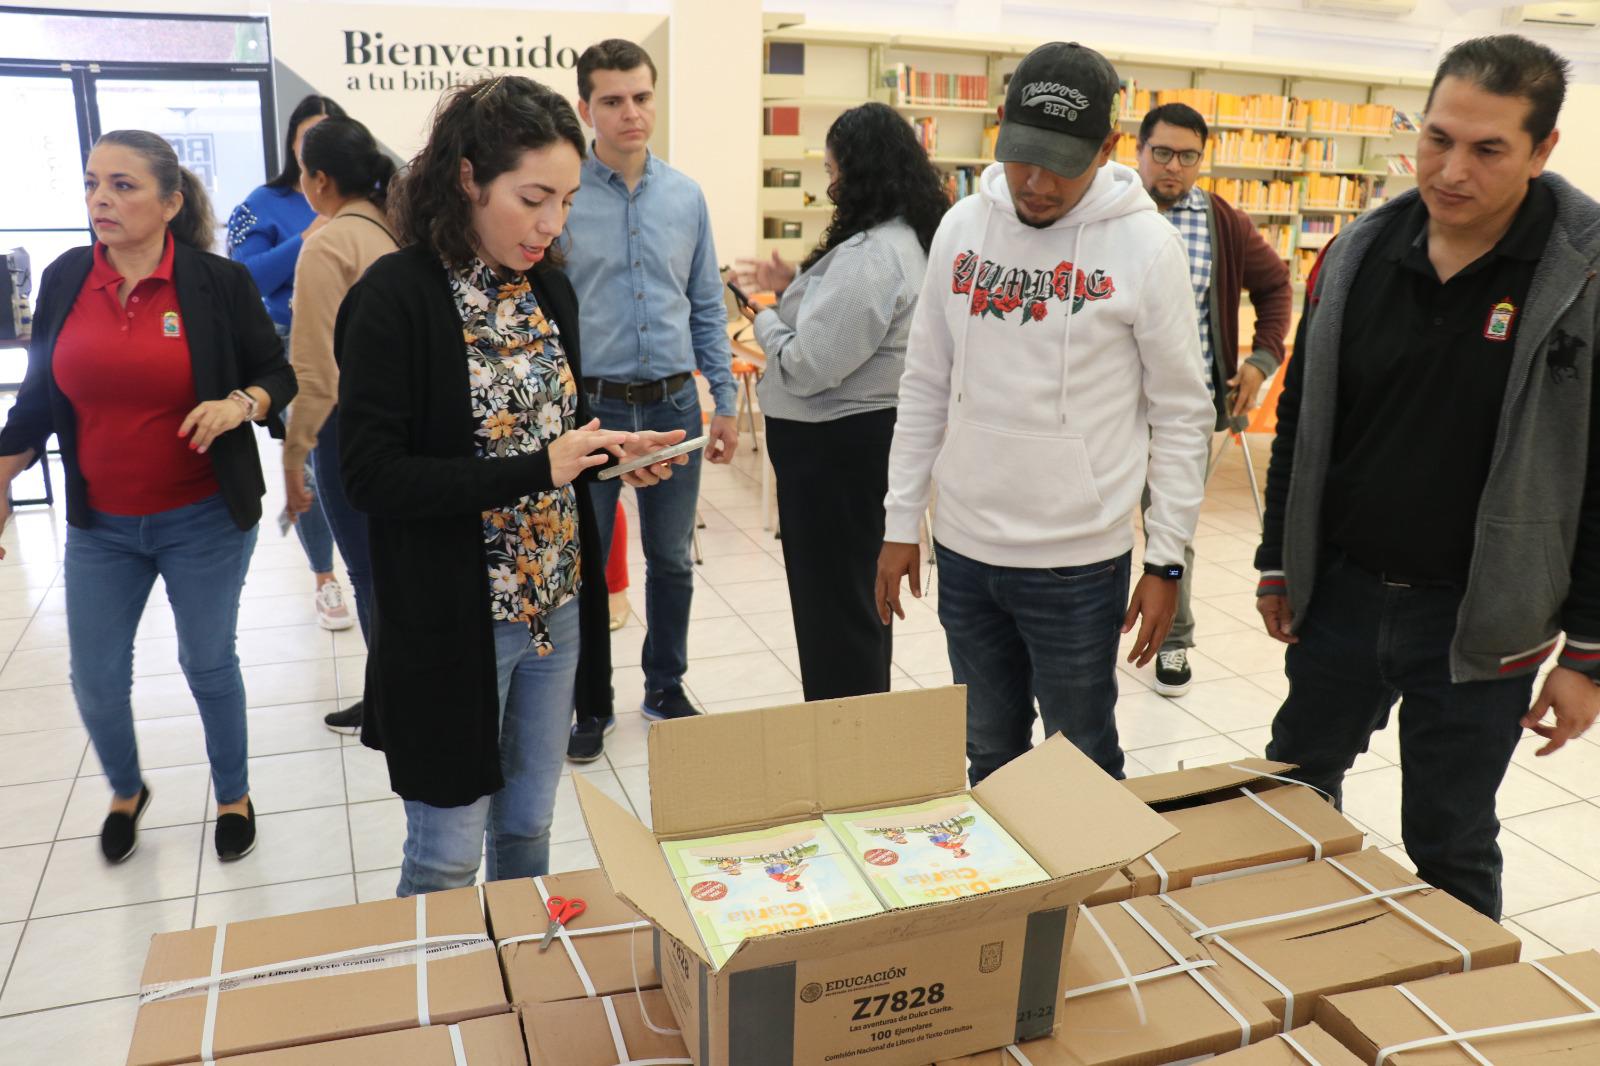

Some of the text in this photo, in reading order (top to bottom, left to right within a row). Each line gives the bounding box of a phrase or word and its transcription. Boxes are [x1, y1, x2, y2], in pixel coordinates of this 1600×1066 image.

[342, 30, 579, 69] Bienvenido
[347, 76, 360, 90] a
[369, 72, 394, 90] tu
[426, 944, 460, 955] omisión
[268, 968, 299, 977] Libros
[314, 963, 340, 971] Texto
[825, 966, 908, 992] EDUCACIÓN
[852, 982, 945, 1021] Z7828
[850, 1024, 862, 1033] Las
[863, 1017, 898, 1029] aventuras
[898, 1014, 908, 1022] de
[909, 1010, 929, 1020] Dulce
[870, 1022, 933, 1042] 100 Ejemplares
[824, 1024, 973, 1062] Comisión Nacional de Libros de Texto Gratuitos
